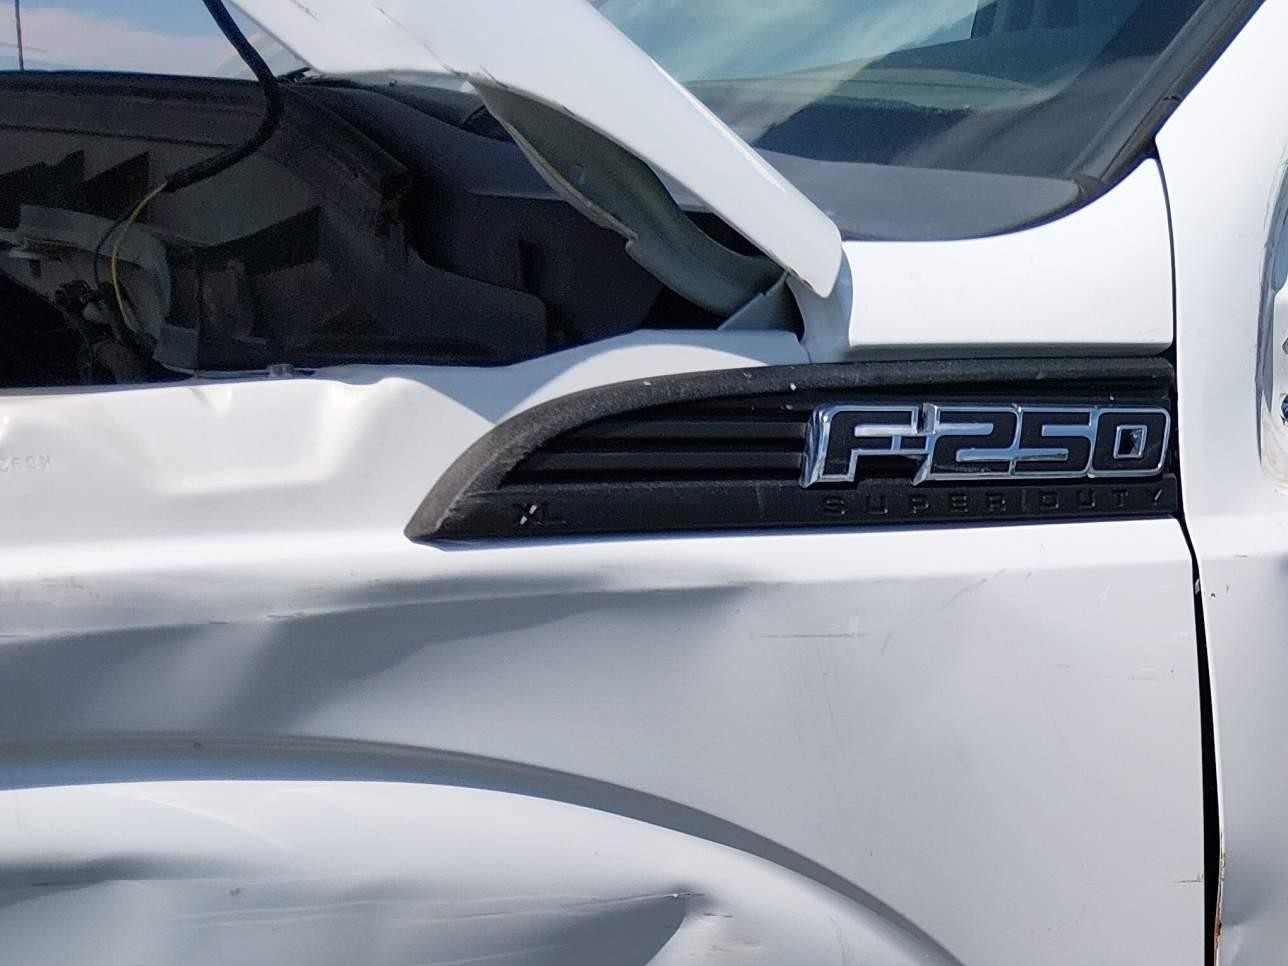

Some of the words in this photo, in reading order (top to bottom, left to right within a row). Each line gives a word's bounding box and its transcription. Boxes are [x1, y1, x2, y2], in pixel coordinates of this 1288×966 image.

[802, 403, 1172, 487] F-250
[823, 490, 1007, 516] SUPER
[1039, 488, 1165, 511] DUTY
